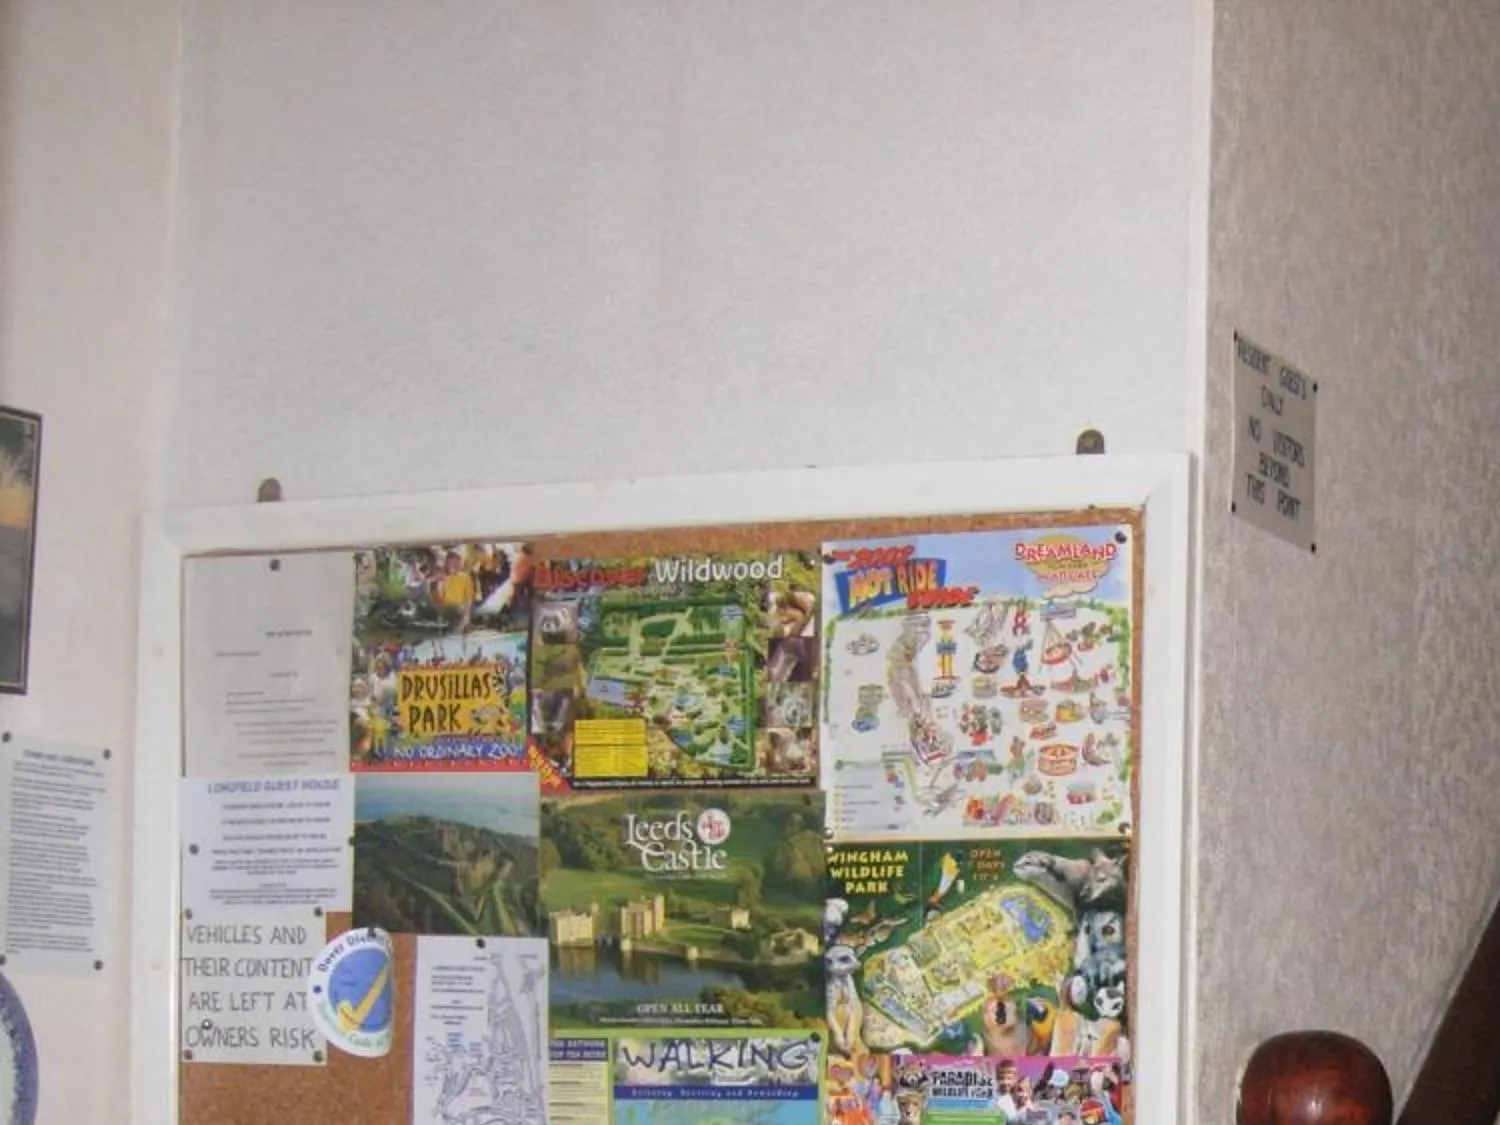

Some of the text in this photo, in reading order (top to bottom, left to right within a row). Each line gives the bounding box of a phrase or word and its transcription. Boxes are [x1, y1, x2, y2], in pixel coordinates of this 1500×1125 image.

[654, 556, 783, 583] Wildwood
[408, 704, 462, 733] PARK
[624, 811, 693, 850] Leeds
[641, 840, 728, 872] Castle
[827, 851, 909, 863] WINGHAM
[831, 866, 905, 878] WILDLIFE
[845, 881, 889, 894] PARK
[186, 925, 307, 945] VEHICLES AND
[182, 957, 313, 978] THEIR CONTENT
[188, 991, 309, 1012] ARE LEFT AT
[185, 1026, 316, 1049] OWNERS RISK
[622, 1039, 811, 1073] WALKING
